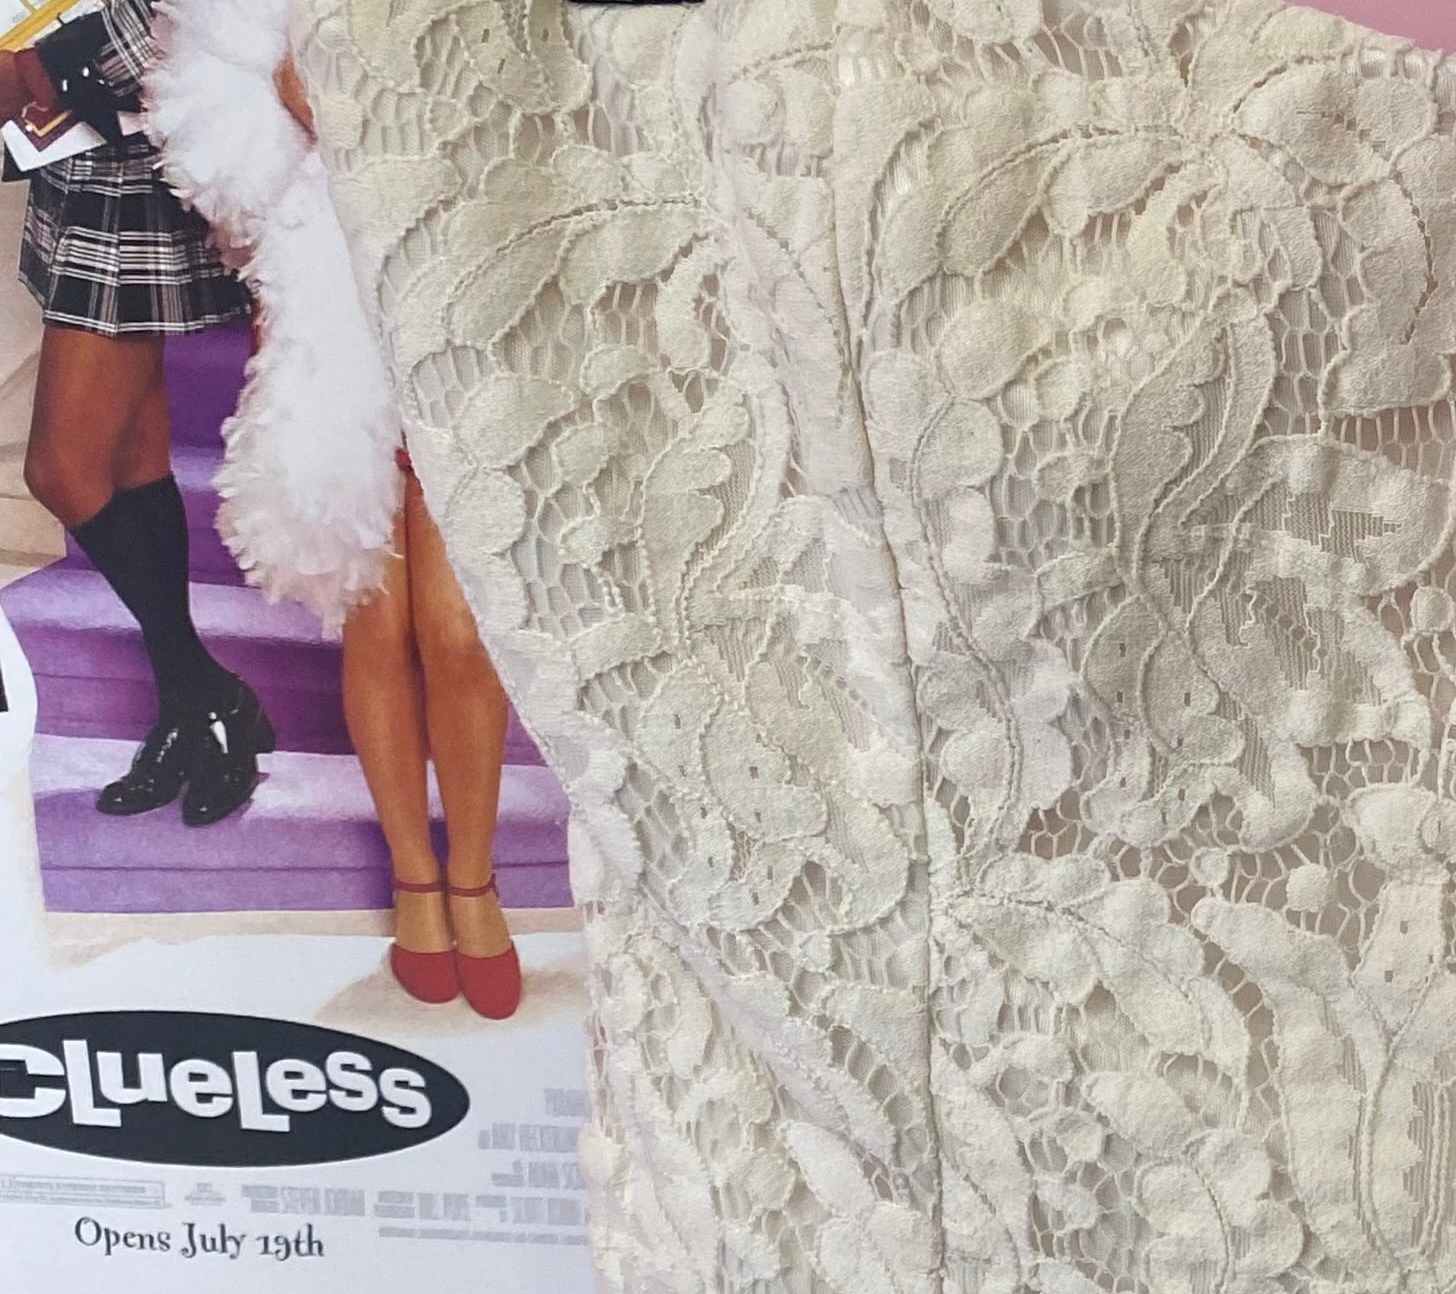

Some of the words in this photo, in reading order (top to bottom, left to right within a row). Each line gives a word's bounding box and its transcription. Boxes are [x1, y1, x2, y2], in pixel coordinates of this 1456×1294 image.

[74, 1216, 171, 1256] Opens
[181, 1222, 247, 1259] July
[257, 1223, 325, 1261] 19th
